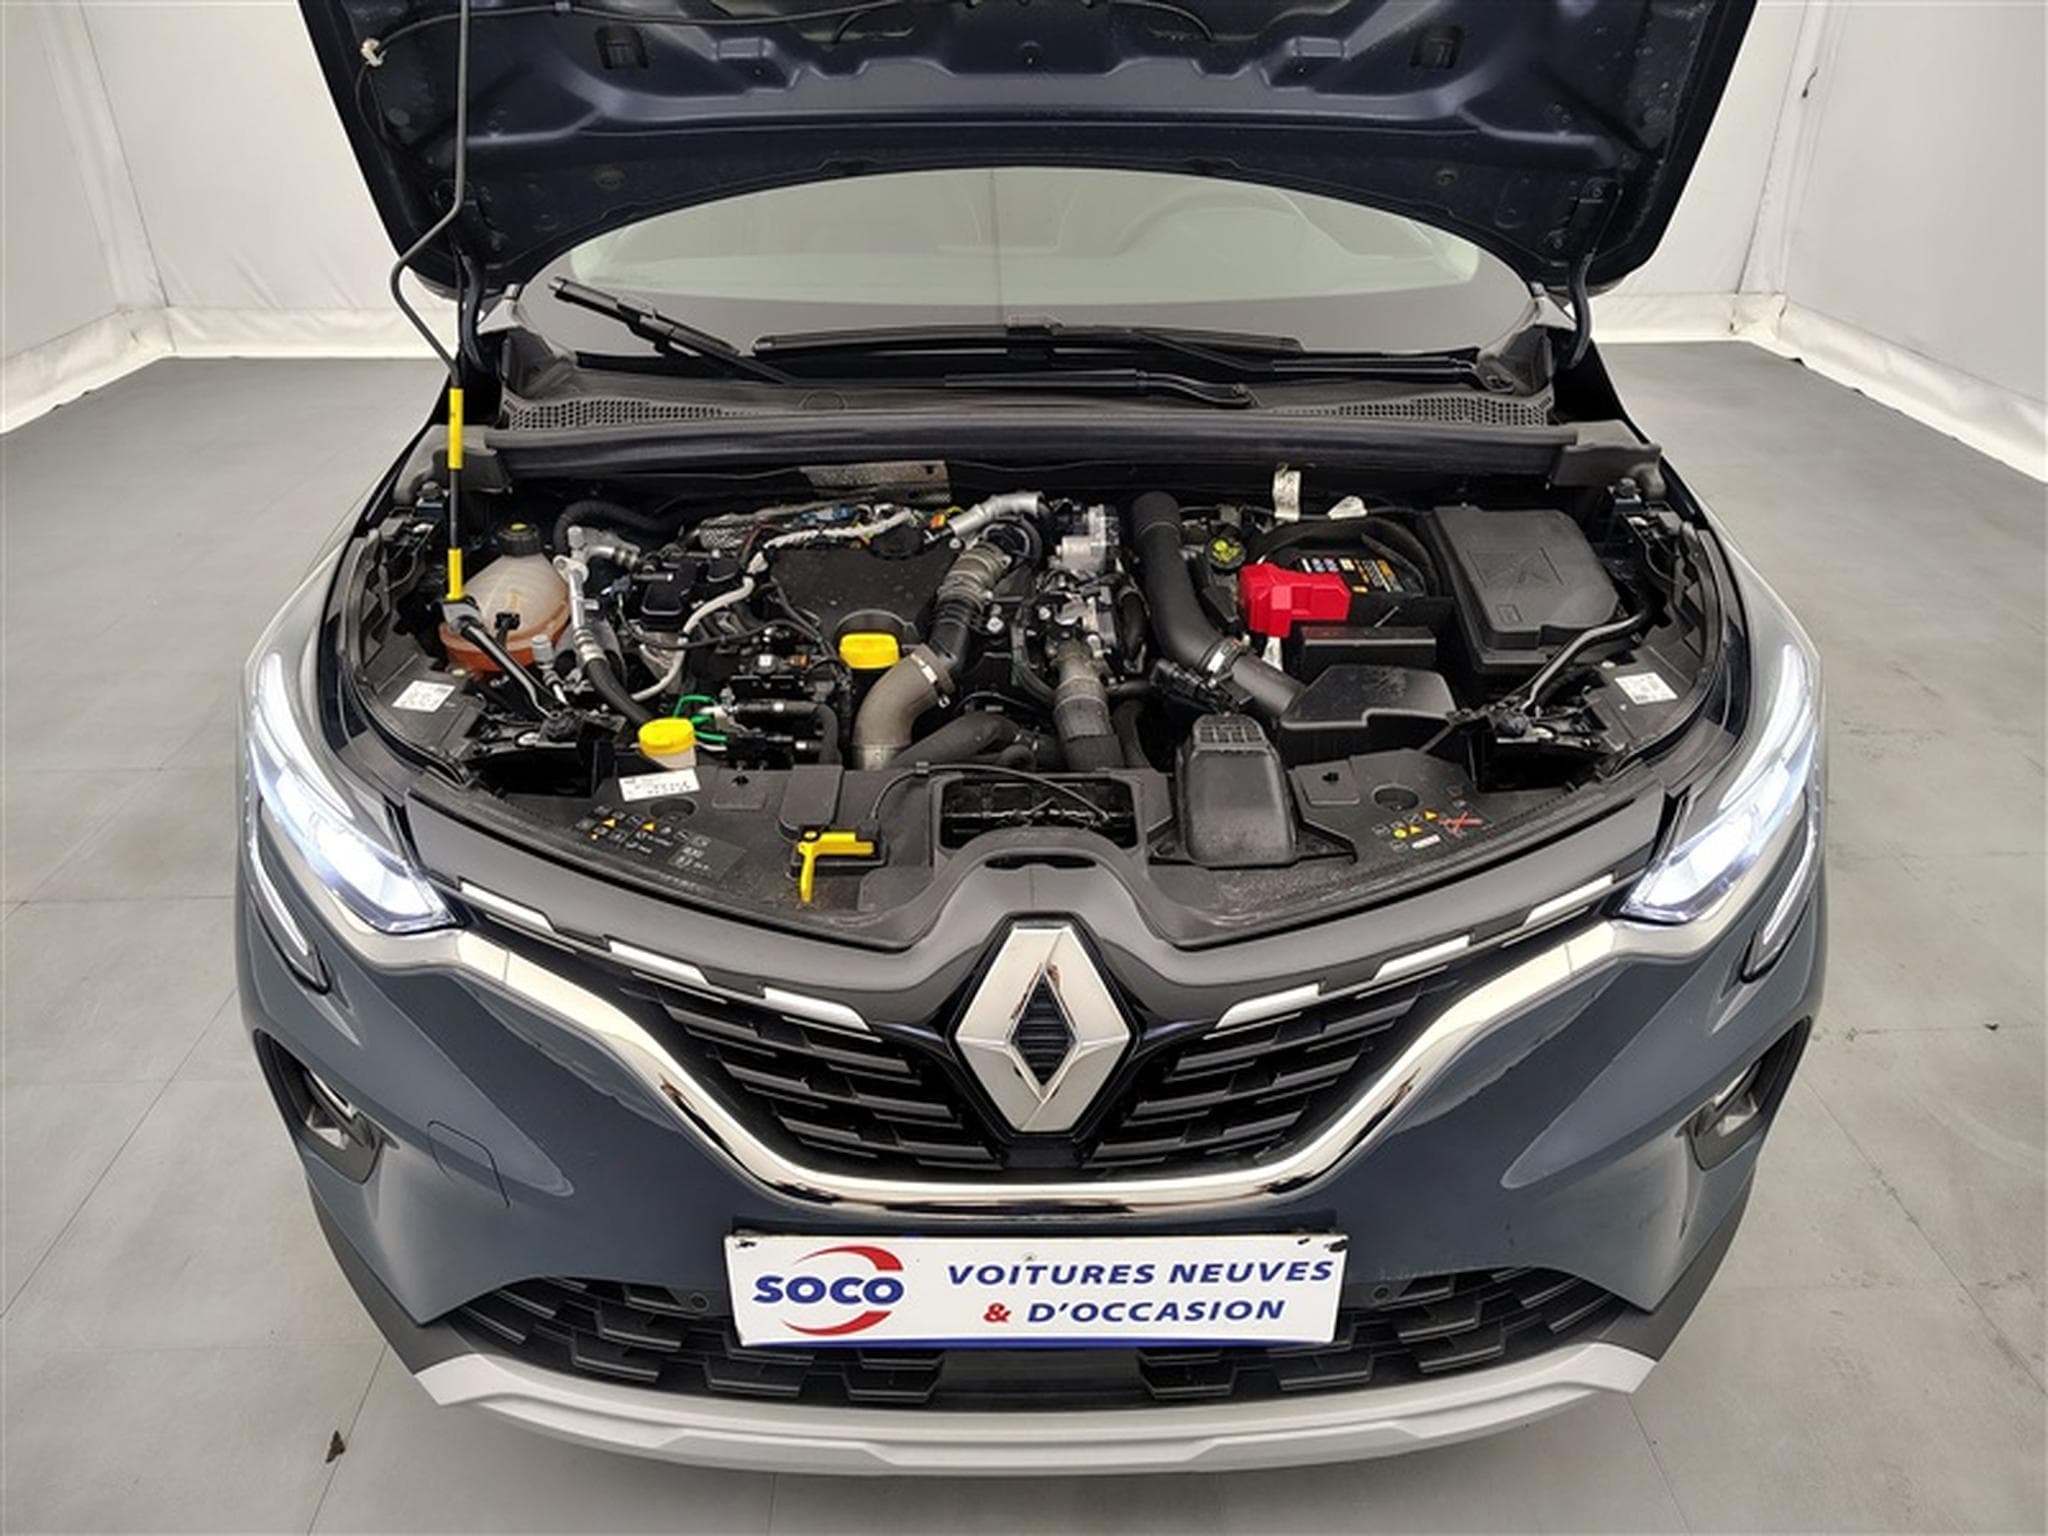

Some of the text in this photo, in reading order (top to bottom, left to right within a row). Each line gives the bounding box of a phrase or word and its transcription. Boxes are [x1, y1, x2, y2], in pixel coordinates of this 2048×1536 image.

[946, 1260, 1333, 1286] VOITURES NEUVES
[752, 1273, 905, 1306] SOCO
[982, 1299, 1286, 1324] & D'OCCASION
